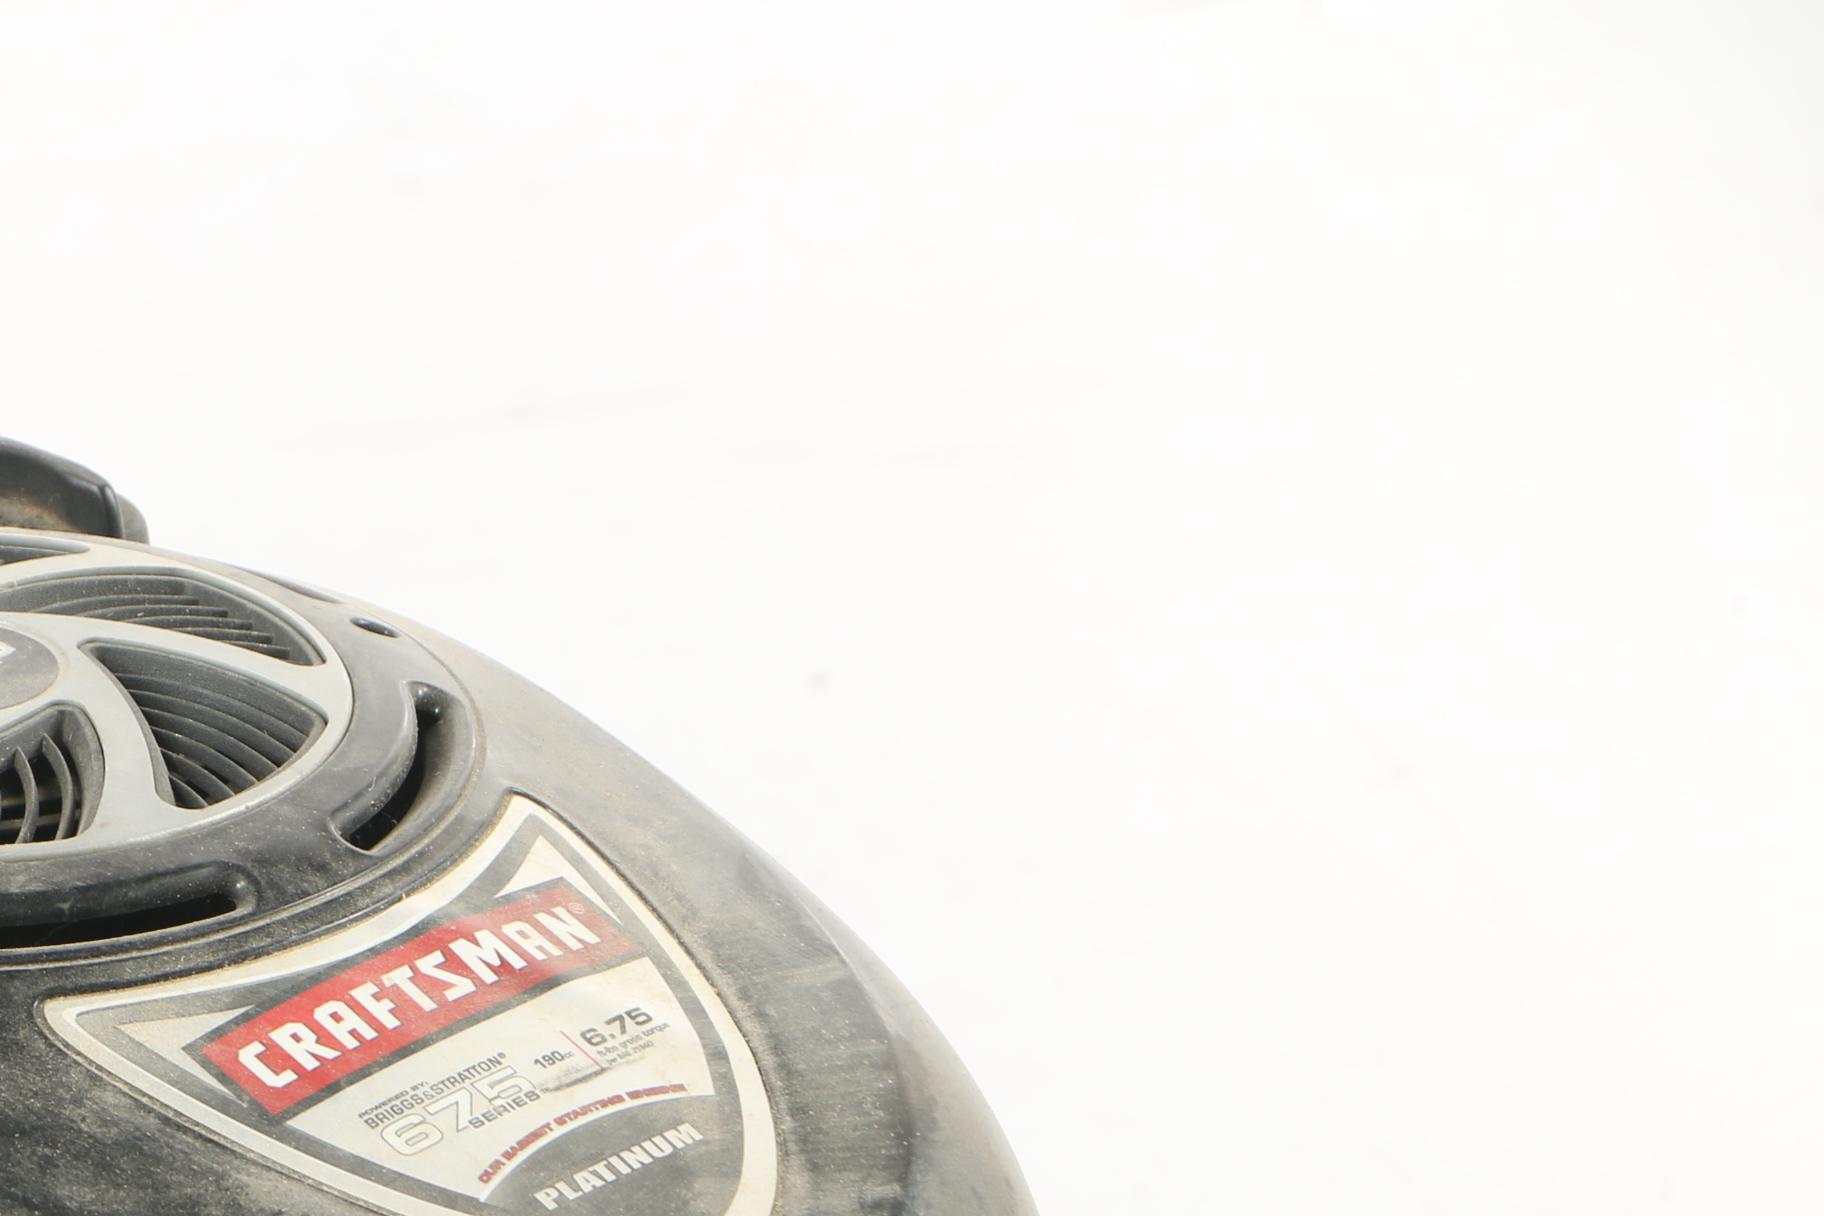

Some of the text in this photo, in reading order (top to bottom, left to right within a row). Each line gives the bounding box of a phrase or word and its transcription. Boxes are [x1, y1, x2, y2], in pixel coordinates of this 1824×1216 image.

[238, 905, 601, 1089] CRAFTSMAN
[579, 1006, 654, 1047] 6.75
[357, 1087, 410, 1120] POWERED
[380, 1065, 537, 1157] 675
[468, 1088, 542, 1130] SERIES
[478, 1158, 504, 1185] OUR
[553, 1092, 626, 1127] STARTING
[532, 1122, 705, 1212] PLATINUM
